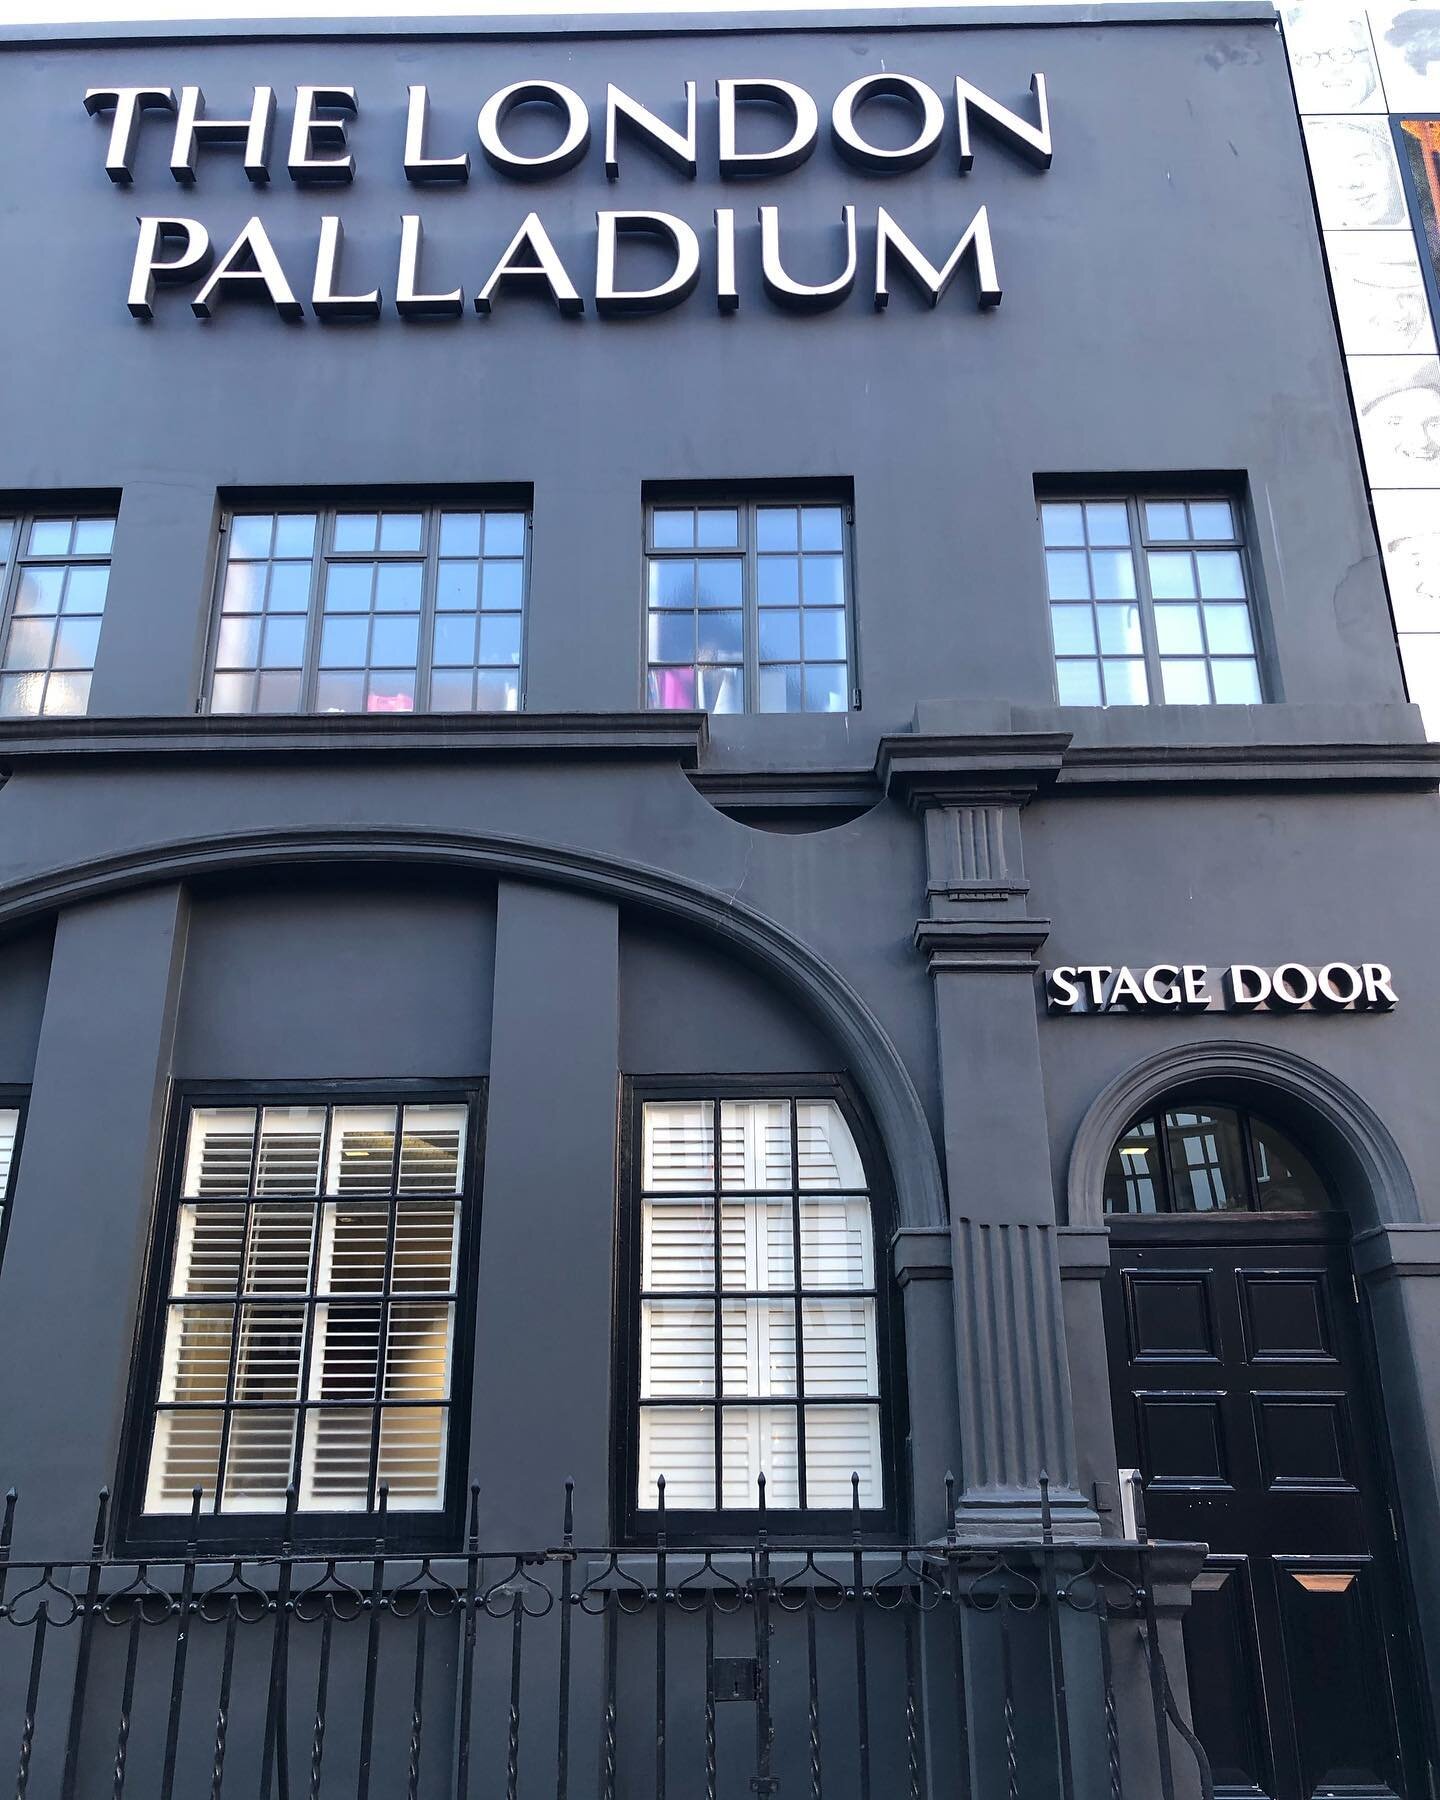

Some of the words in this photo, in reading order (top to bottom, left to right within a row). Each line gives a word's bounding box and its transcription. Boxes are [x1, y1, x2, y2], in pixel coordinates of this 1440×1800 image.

[84, 85, 358, 179] THE
[404, 73, 1052, 178] LONDON
[127, 205, 1002, 316] PALLADIUM
[1052, 964, 1212, 1006] STAGE
[1230, 962, 1400, 1004] DOOR
